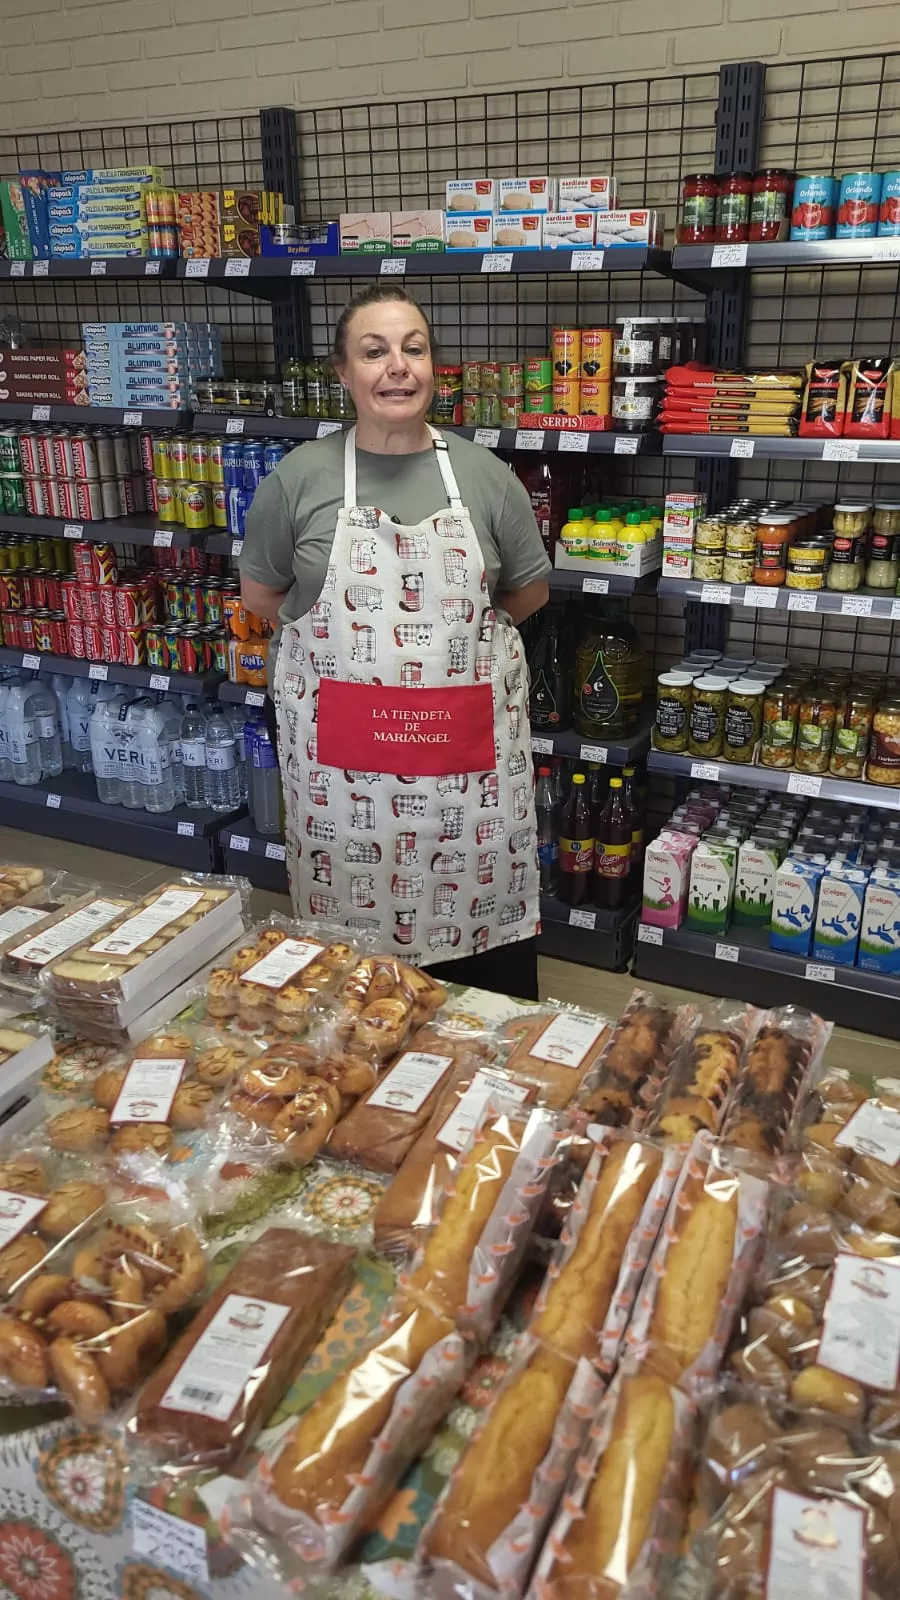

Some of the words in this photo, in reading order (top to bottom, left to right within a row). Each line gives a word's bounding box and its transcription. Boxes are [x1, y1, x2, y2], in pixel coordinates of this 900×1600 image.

[800, 190, 826, 198] Orlando
[846, 186, 872, 194] Orlando
[127, 342, 161, 350] ALUMINIO
[128, 360, 162, 368] ALUMINIO
[129, 376, 162, 385] ALUMINIO
[131, 394, 164, 402] ALUMINIO
[542, 416, 578, 428] SERPIS
[72, 441, 81, 478] AMBAR
[101, 590, 115, 625] Coca-Cola
[69, 624, 85, 658] Coca-Cola
[240, 655, 264, 666] FANTA
[373, 709, 388, 719] LA
[391, 710, 452, 720] TIENDETA
[405, 722, 421, 731] DE
[373, 731, 451, 743] MARIANGEL
[104, 748, 145, 765] VERI
